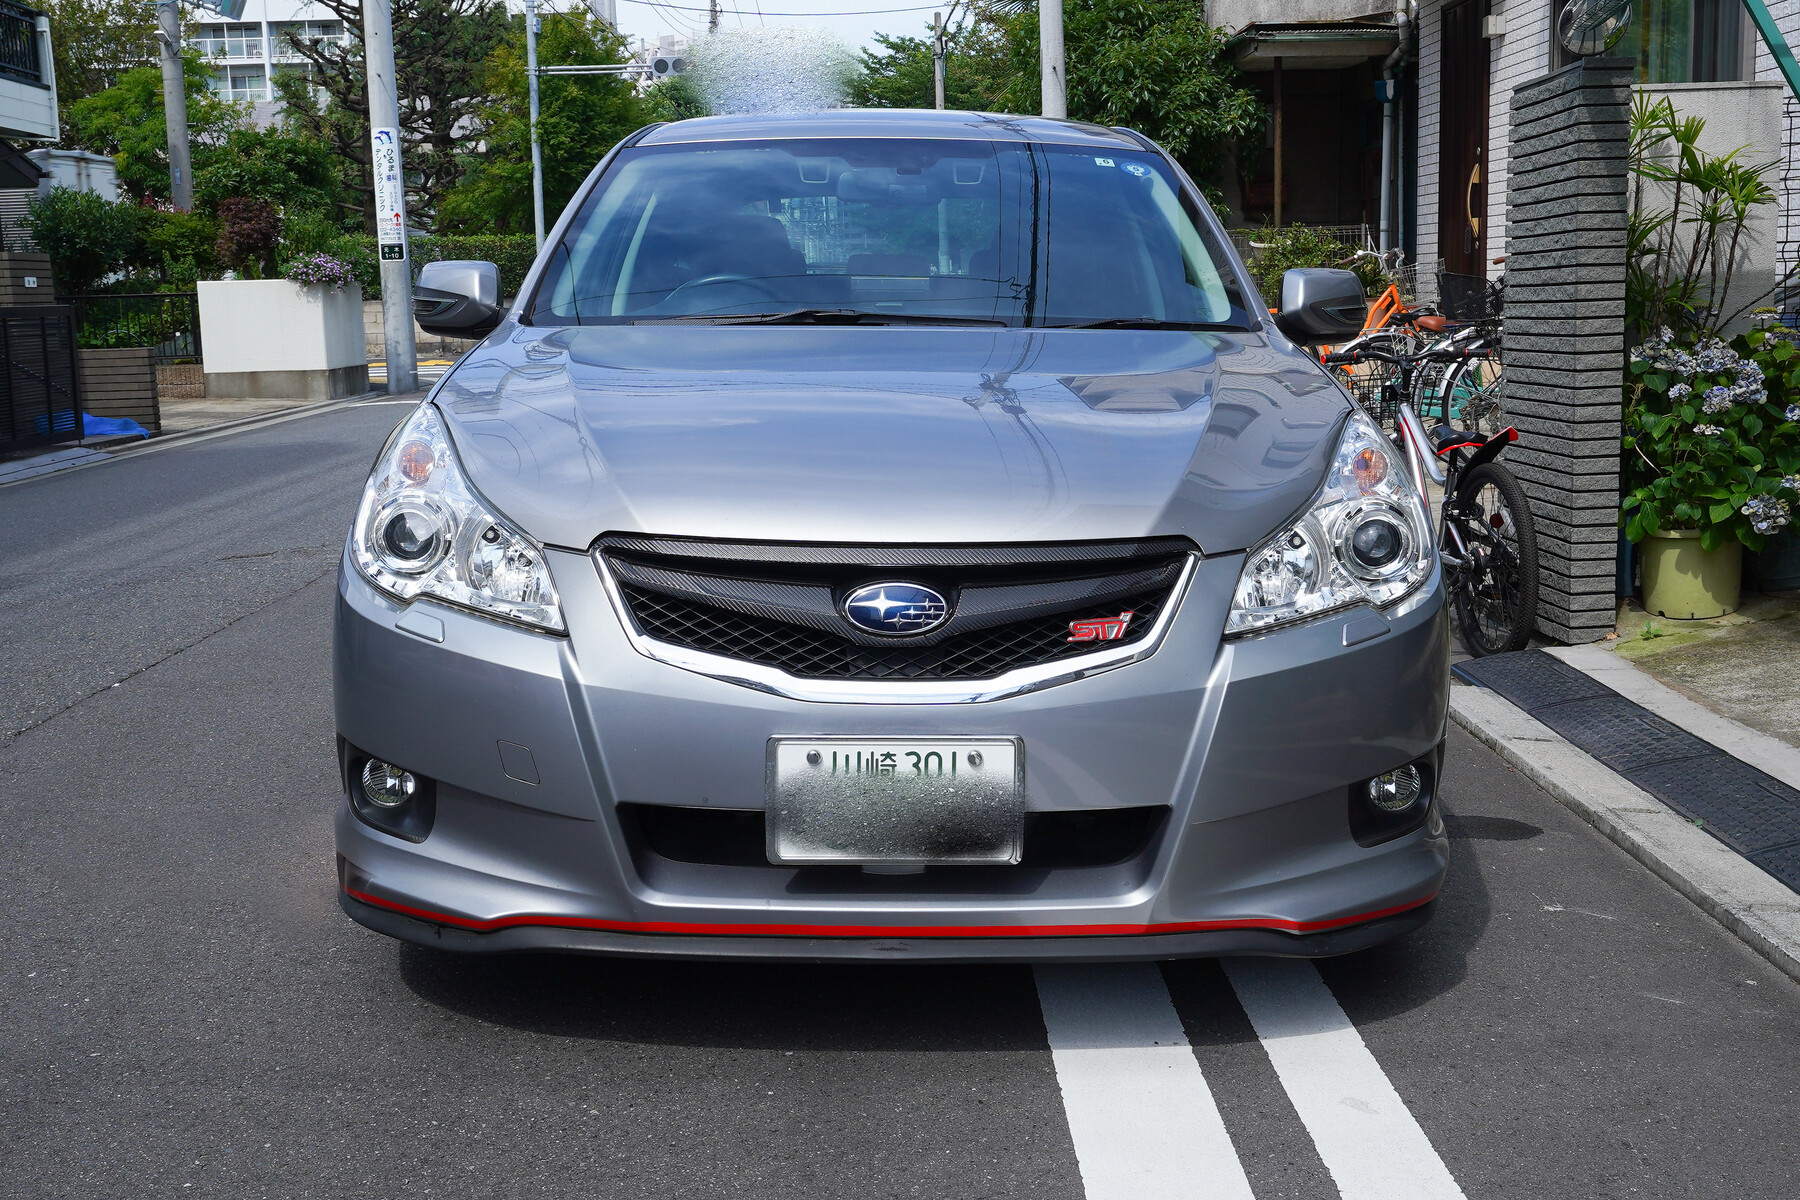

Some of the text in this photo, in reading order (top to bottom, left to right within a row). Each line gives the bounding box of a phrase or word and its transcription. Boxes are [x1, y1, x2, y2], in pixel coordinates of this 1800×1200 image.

[375, 148, 386, 212] デンタルクリニック
[830, 750, 897, 778] 川崎
